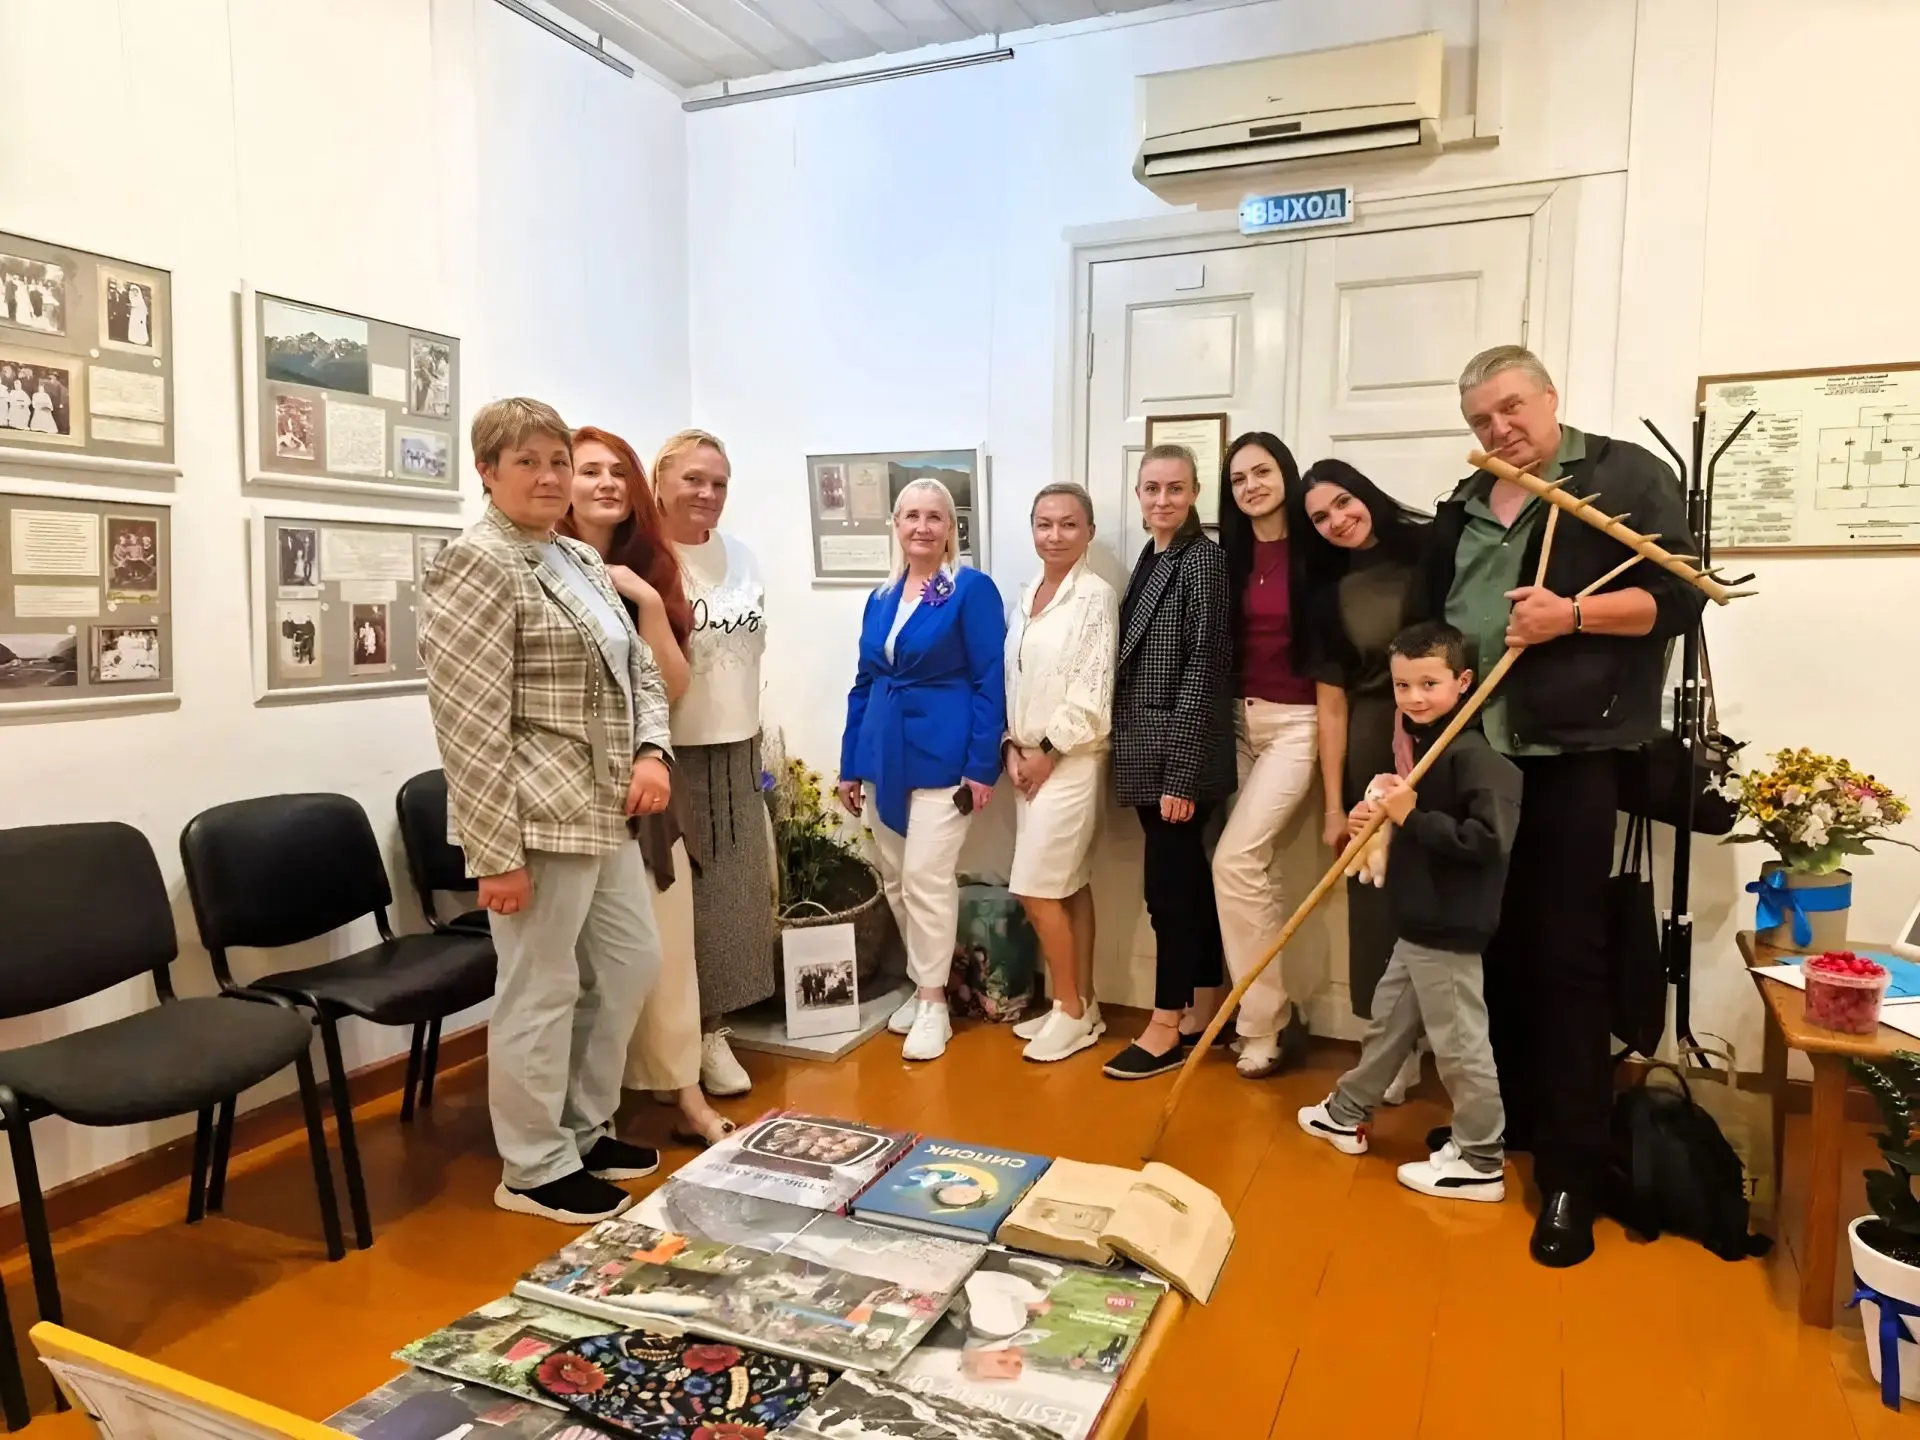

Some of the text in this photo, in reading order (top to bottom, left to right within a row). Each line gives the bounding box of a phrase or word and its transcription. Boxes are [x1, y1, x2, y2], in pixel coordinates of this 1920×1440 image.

[1251, 193, 1342, 225] ВЫХОД
[924, 1144, 1027, 1168] СИПСИК
[1015, 1401, 1085, 1439] EESTI
